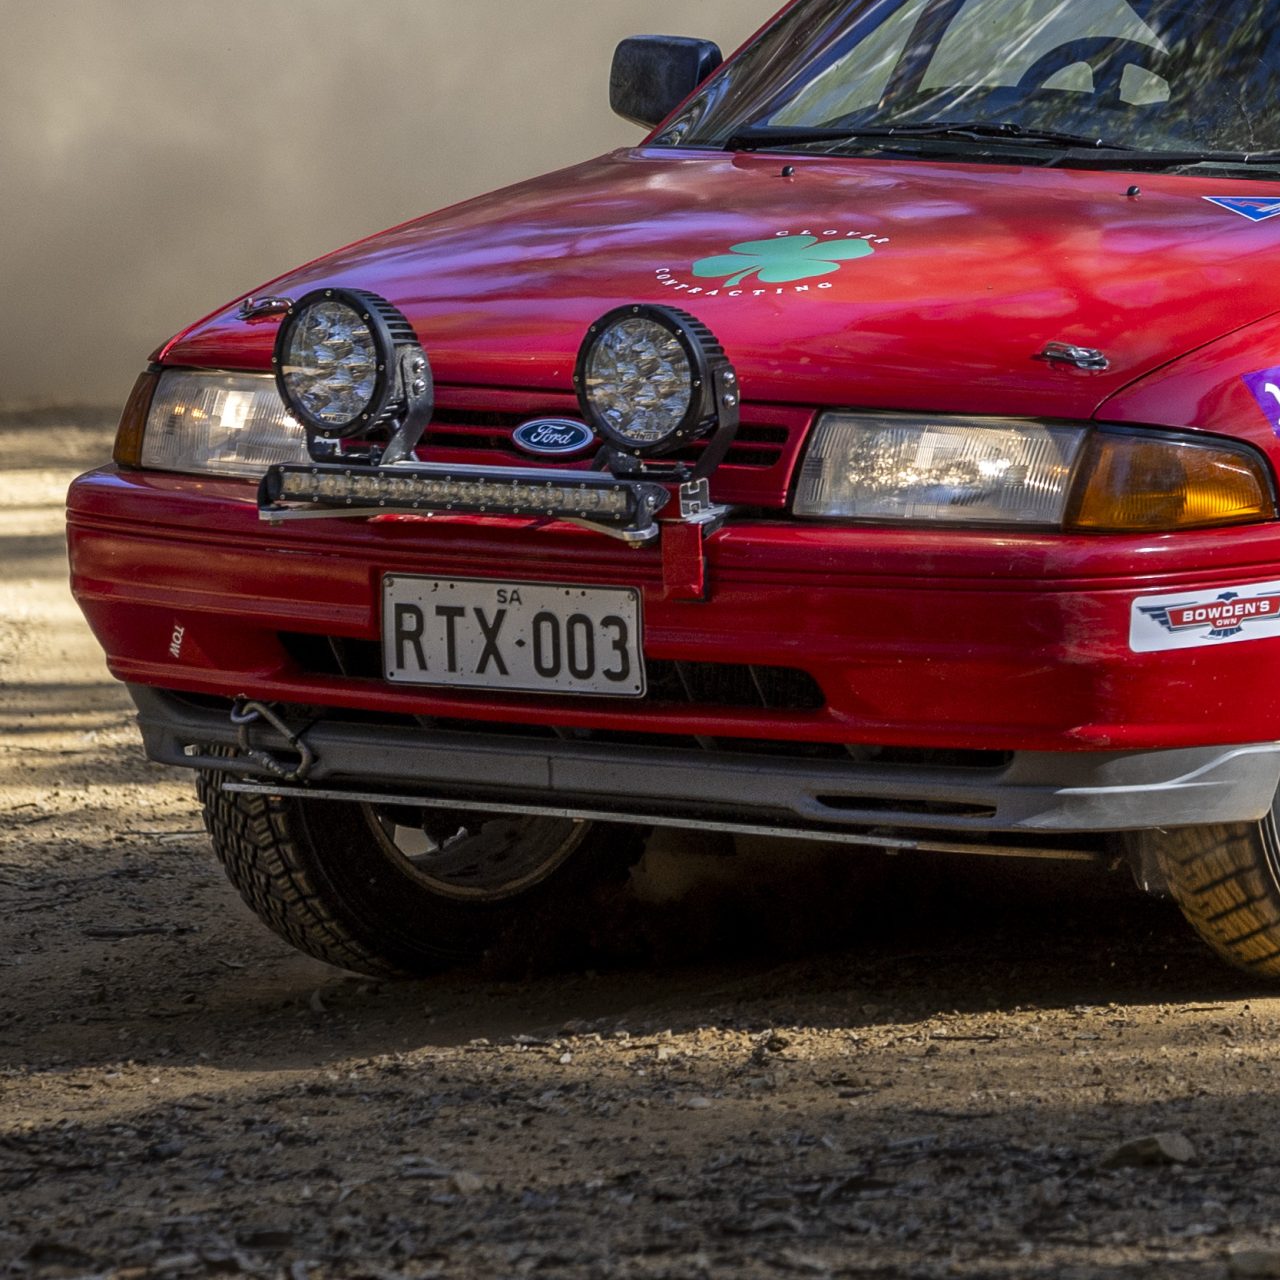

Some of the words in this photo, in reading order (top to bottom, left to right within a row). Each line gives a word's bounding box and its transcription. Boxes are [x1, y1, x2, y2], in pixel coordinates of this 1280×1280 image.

[775, 228, 890, 245] CLOVER
[655, 267, 833, 297] CONTRACTING
[530, 424, 575, 444] Ford
[496, 589, 523, 606] SA
[1182, 600, 1271, 622] BOWDEN'S
[1216, 618, 1238, 627] OWN
[169, 625, 185, 659] TOW
